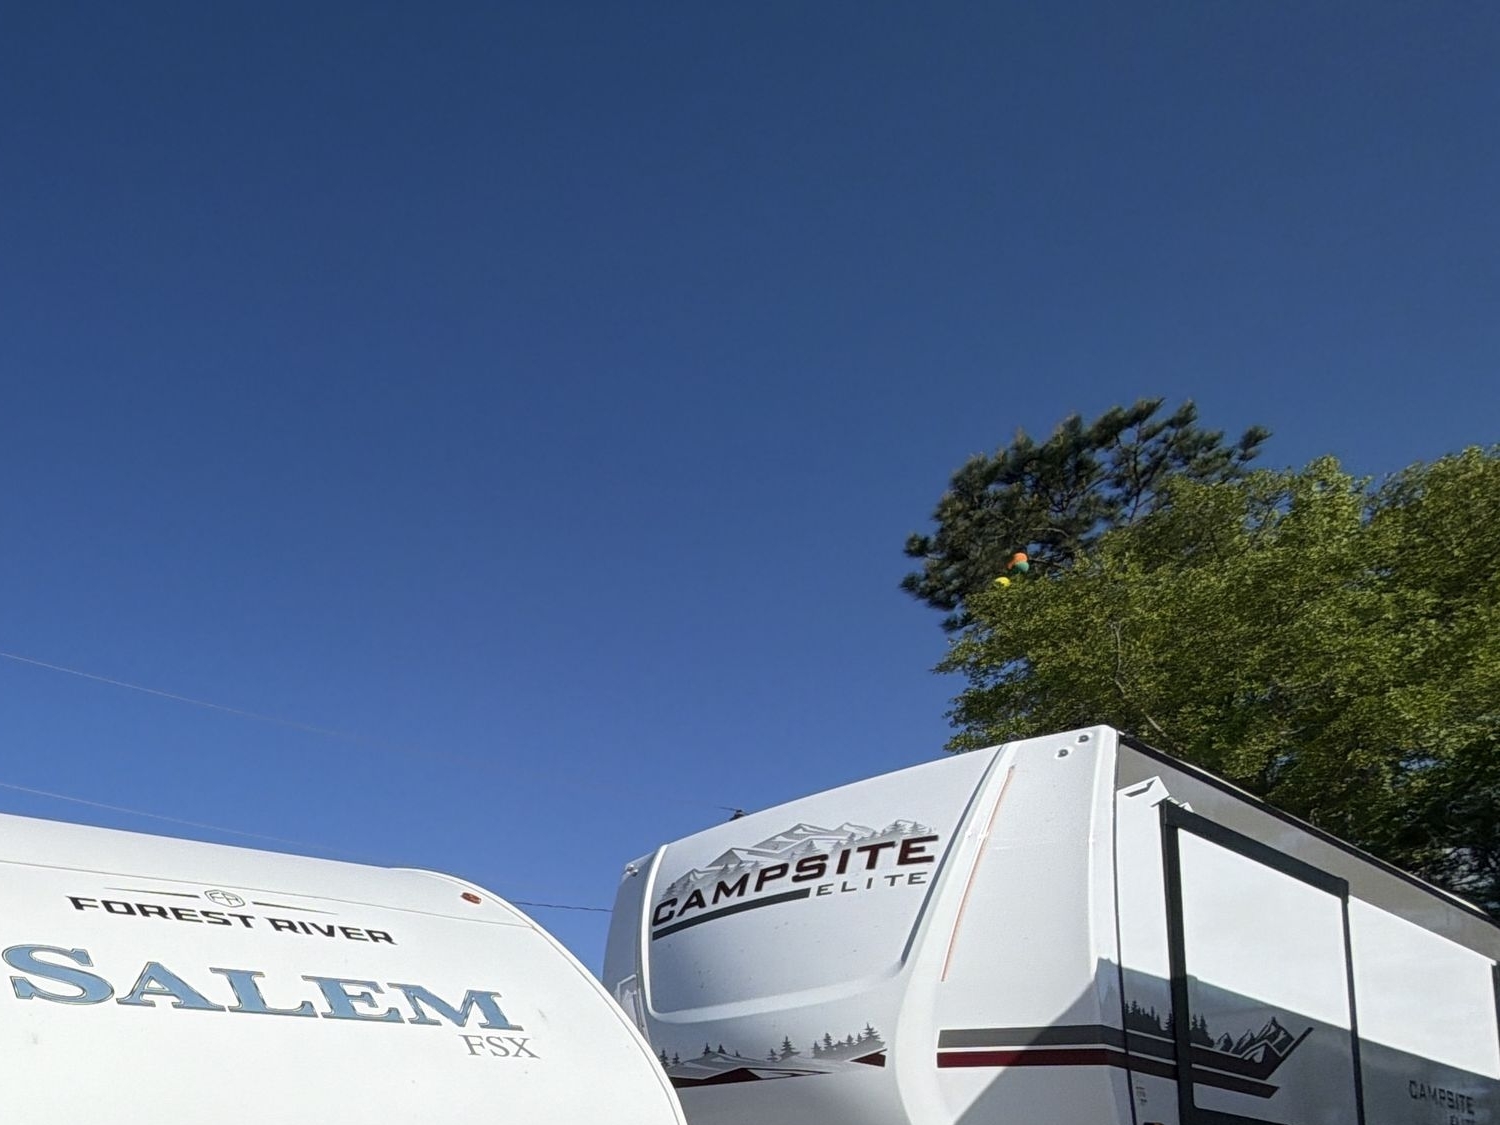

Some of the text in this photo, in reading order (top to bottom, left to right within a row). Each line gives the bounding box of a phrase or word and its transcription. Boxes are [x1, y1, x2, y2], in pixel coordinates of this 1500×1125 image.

[651, 834, 939, 927] CAMPSITE
[816, 872, 928, 897] ELITE
[65, 895, 398, 945] FOREST RIVER
[1, 943, 525, 1032] SALEM
[458, 1034, 540, 1060] FSX
[1408, 1080, 1475, 1115] CAMPSITE
